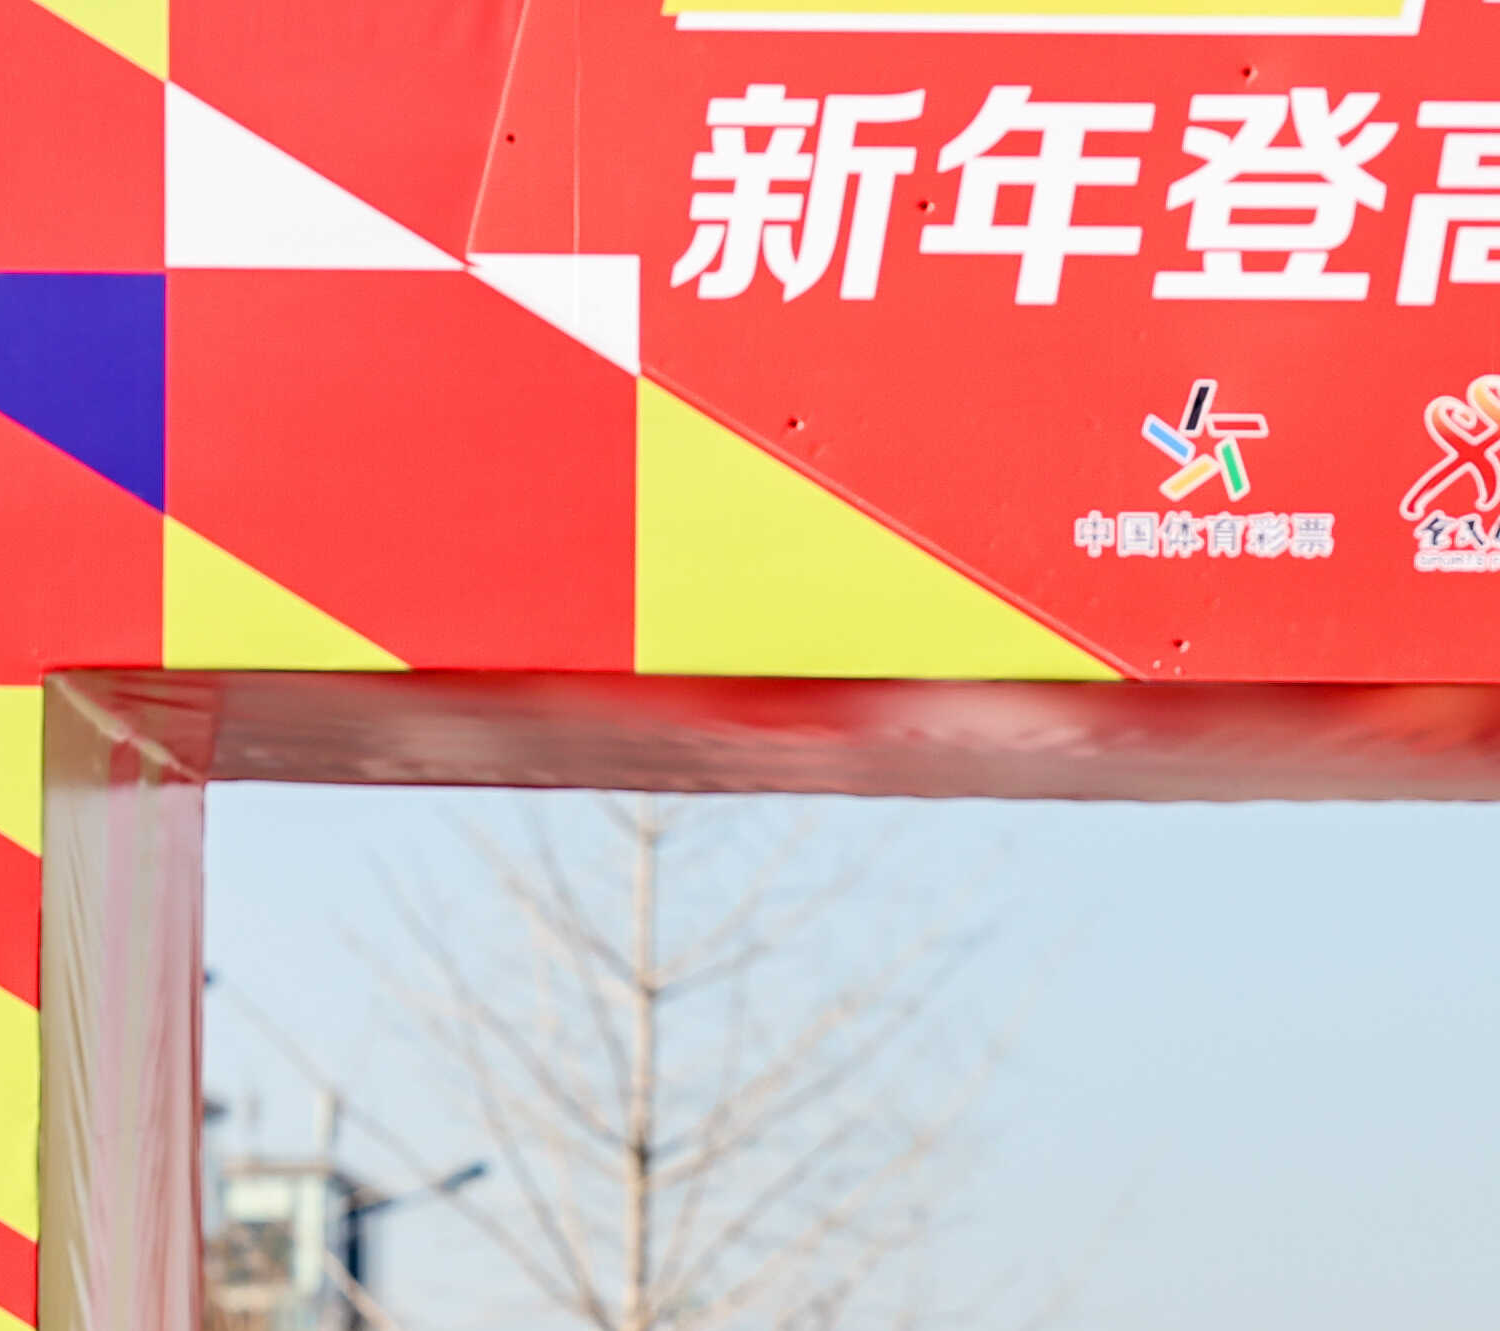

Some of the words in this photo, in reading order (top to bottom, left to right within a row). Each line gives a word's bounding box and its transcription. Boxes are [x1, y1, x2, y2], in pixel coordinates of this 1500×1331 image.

[1076, 511, 1334, 557] 中国体育彩票
